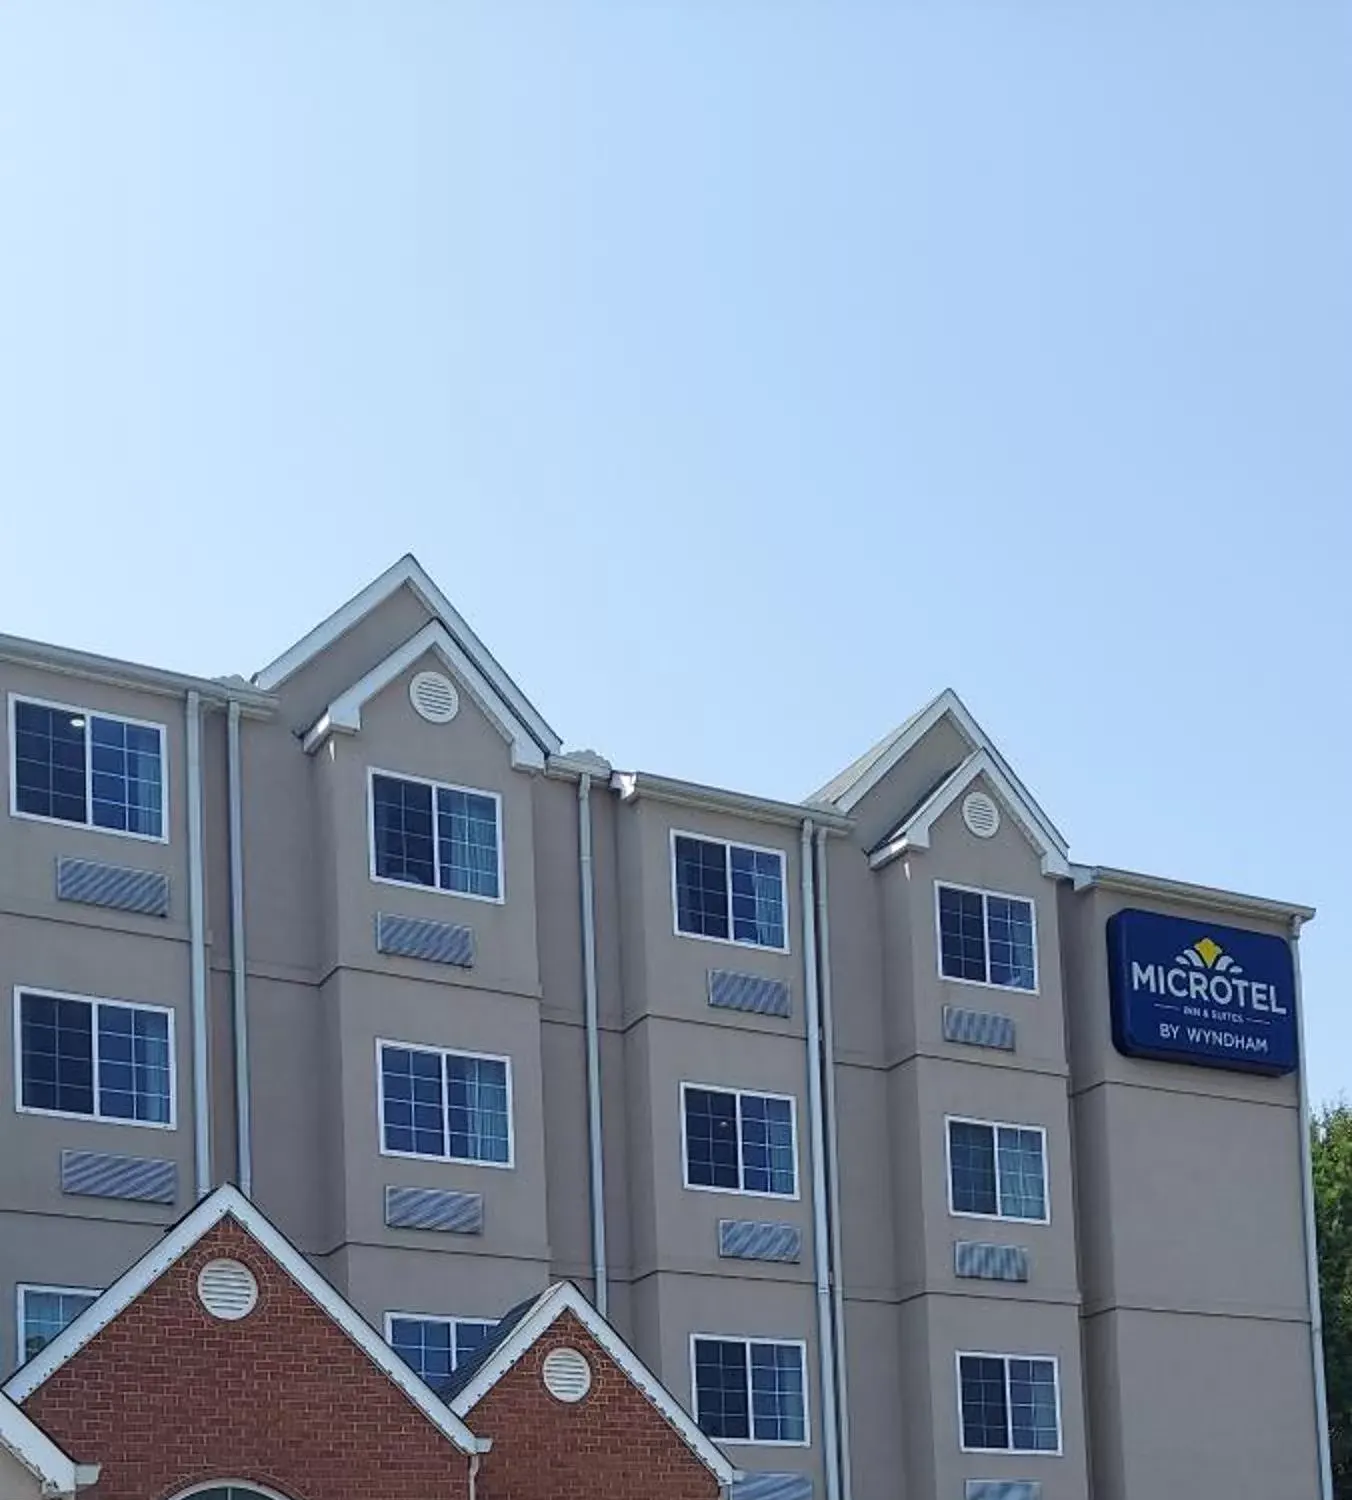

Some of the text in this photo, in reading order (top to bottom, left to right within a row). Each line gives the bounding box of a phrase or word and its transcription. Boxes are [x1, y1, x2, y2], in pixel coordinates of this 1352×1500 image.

[1131, 961, 1287, 1015] MICROTEL
[1183, 1005, 1244, 1023] INN & SUITES
[1160, 1023, 1268, 1053] BY WYNDHAM
